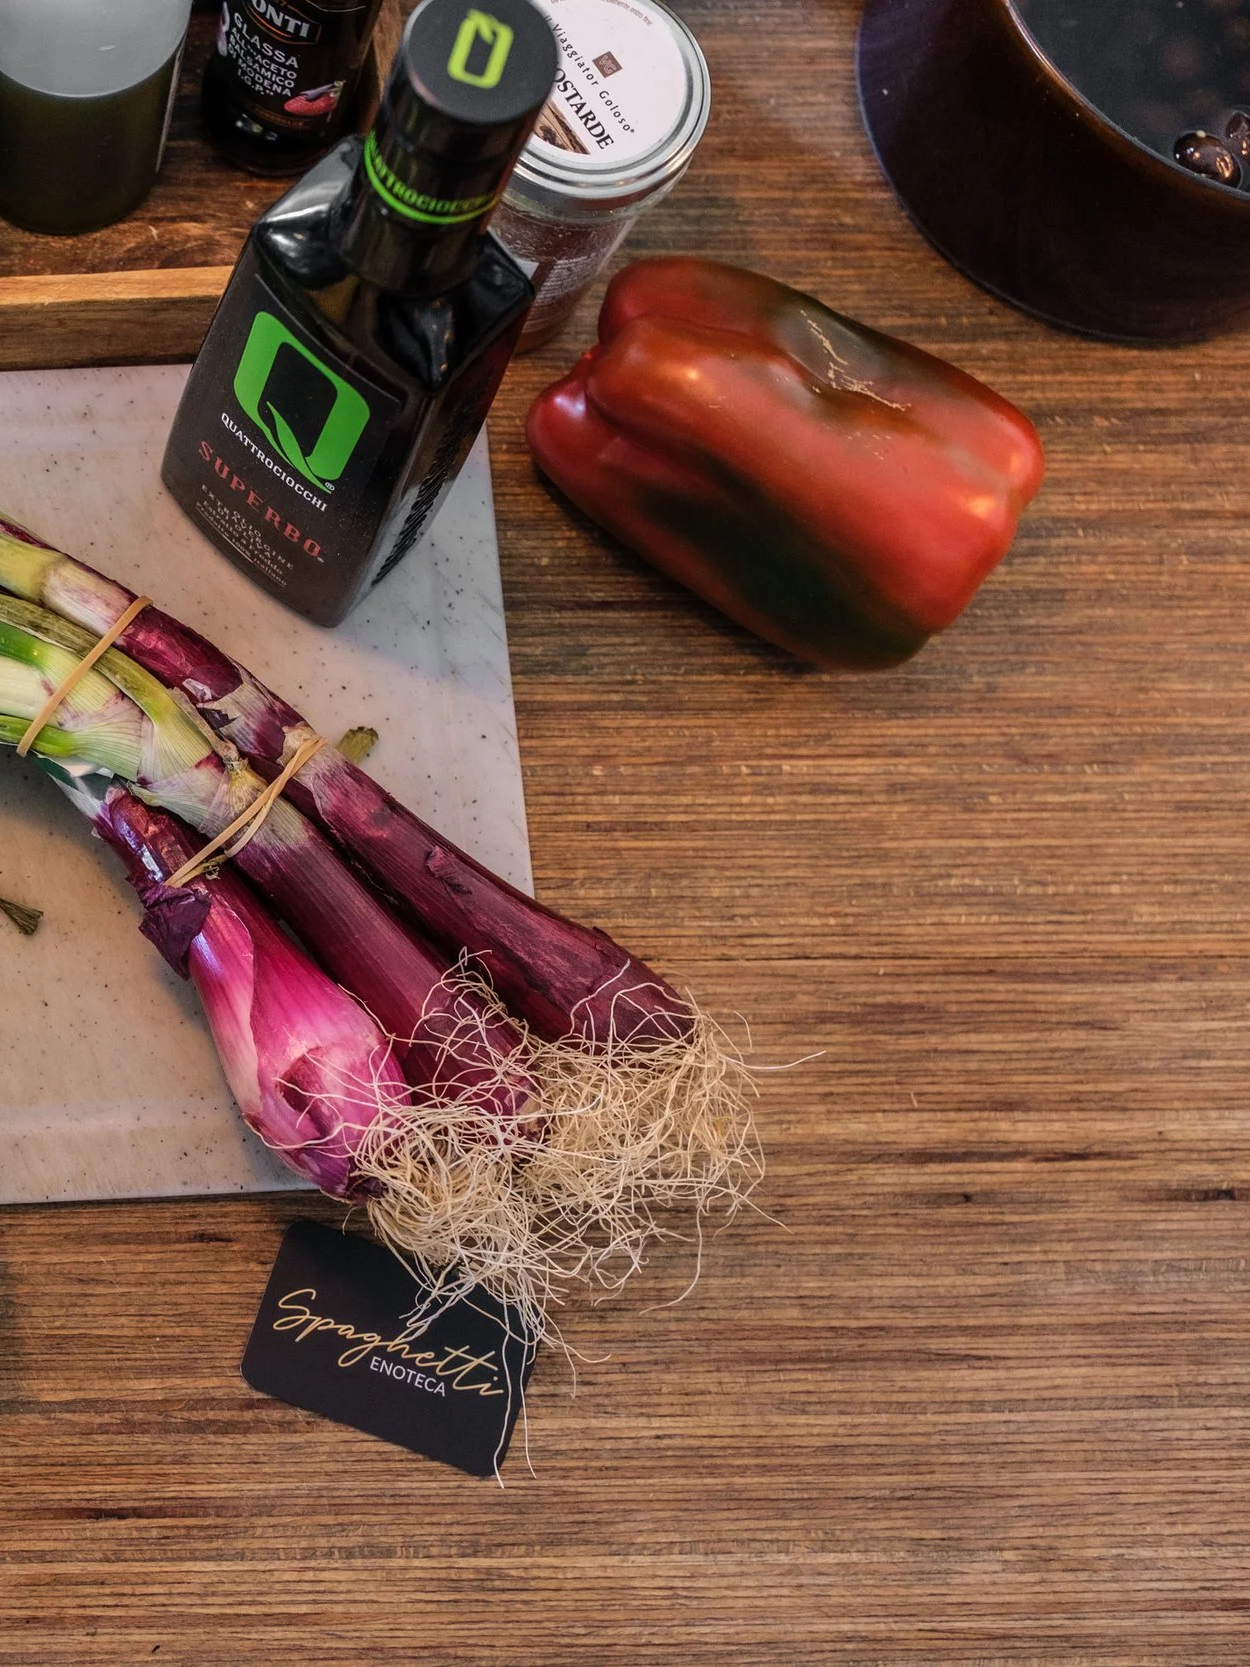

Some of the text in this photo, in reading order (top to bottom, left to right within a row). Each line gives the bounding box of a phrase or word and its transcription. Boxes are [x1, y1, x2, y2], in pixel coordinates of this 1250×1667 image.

[234, 12, 299, 69] GLASSA
[252, 0, 310, 37] ONTI
[227, 43, 291, 97] DI MODENA
[229, 34, 295, 88] BALSAMICO
[552, 23, 599, 86] Viaggiator
[598, 54, 617, 75] VG
[554, 67, 614, 150] OSTARDE
[221, 412, 328, 512] QUATTROCIOCCHI
[199, 440, 321, 557] SUPERBO
[203, 500, 239, 537] Estratto
[233, 511, 261, 537] OLIO
[202, 484, 294, 570] EXTRAVERGINE
[273, 1288, 504, 1396] Spaghetti
[370, 1356, 446, 1397] ENOTECA
